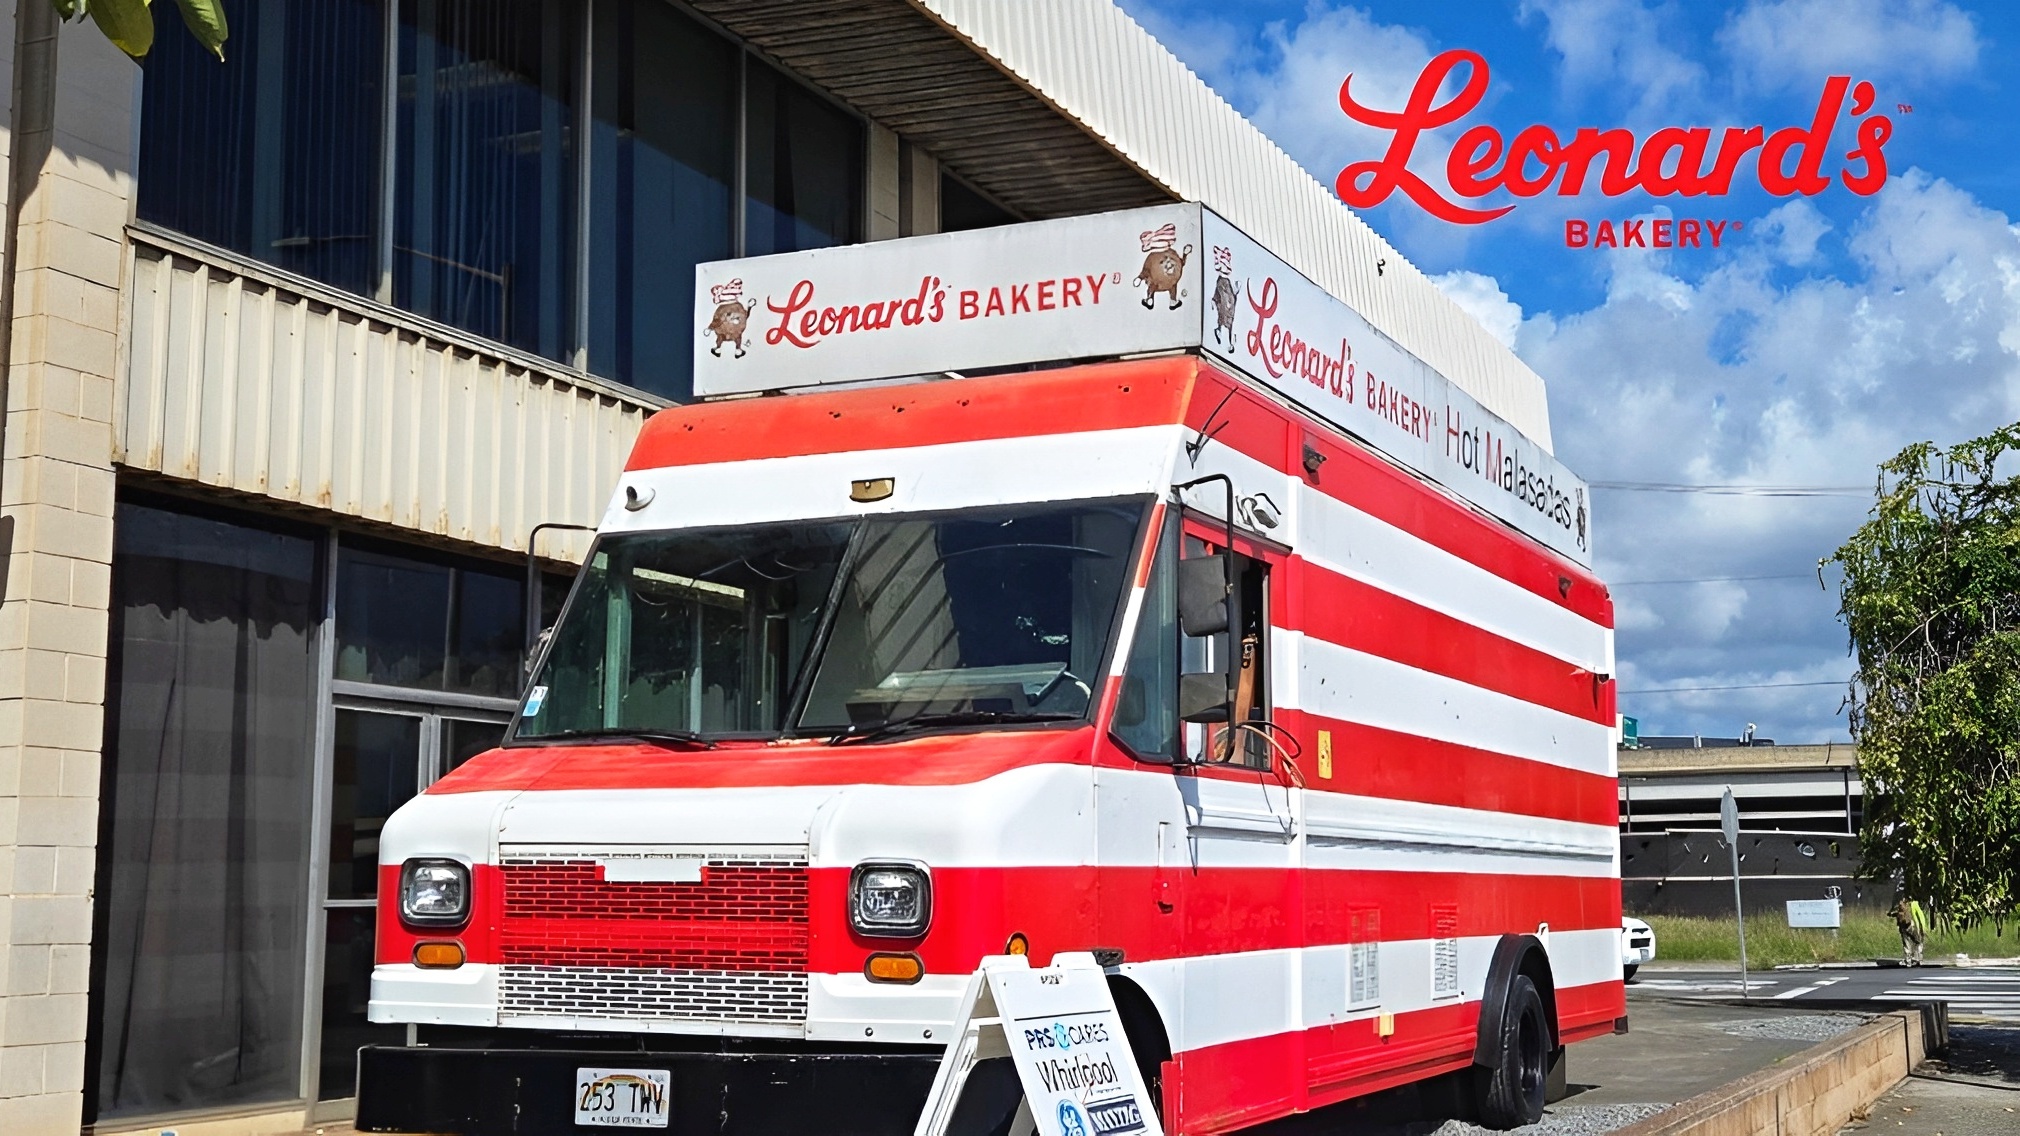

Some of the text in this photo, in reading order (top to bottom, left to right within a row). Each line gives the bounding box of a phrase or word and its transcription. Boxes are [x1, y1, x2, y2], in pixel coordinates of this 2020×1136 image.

[765, 272, 1108, 350] Leonard's BAKERY
[1246, 277, 1572, 531] Leonard's BAKERY Hot Malasadas
[580, 1082, 615, 1112] 253
[1035, 1052, 1119, 1096] Whirlpool
